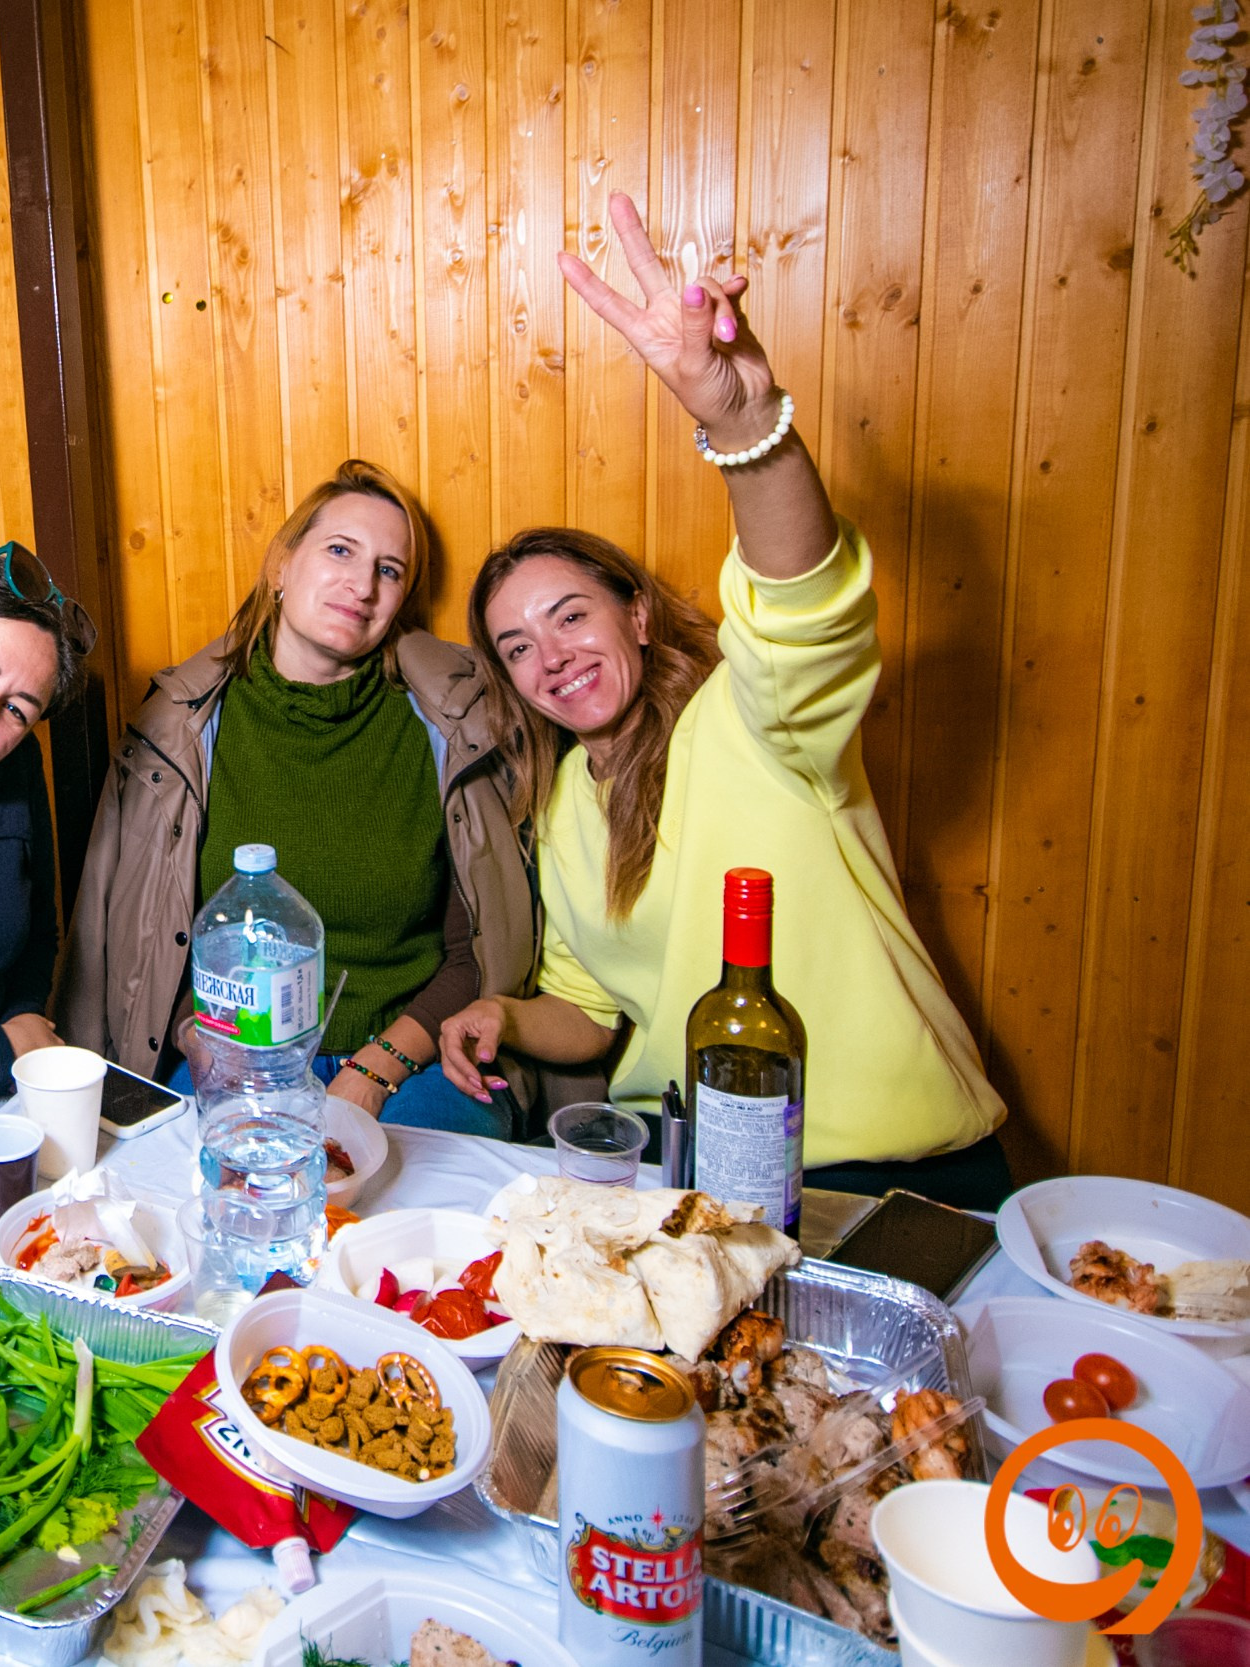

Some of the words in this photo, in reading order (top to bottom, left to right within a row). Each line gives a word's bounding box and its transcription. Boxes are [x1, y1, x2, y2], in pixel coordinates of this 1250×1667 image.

[608, 1514, 643, 1525] ANNO
[591, 1545, 702, 1584] STELLA
[590, 1572, 703, 1610] ARTOIS
[609, 1627, 693, 1657] Belgium
